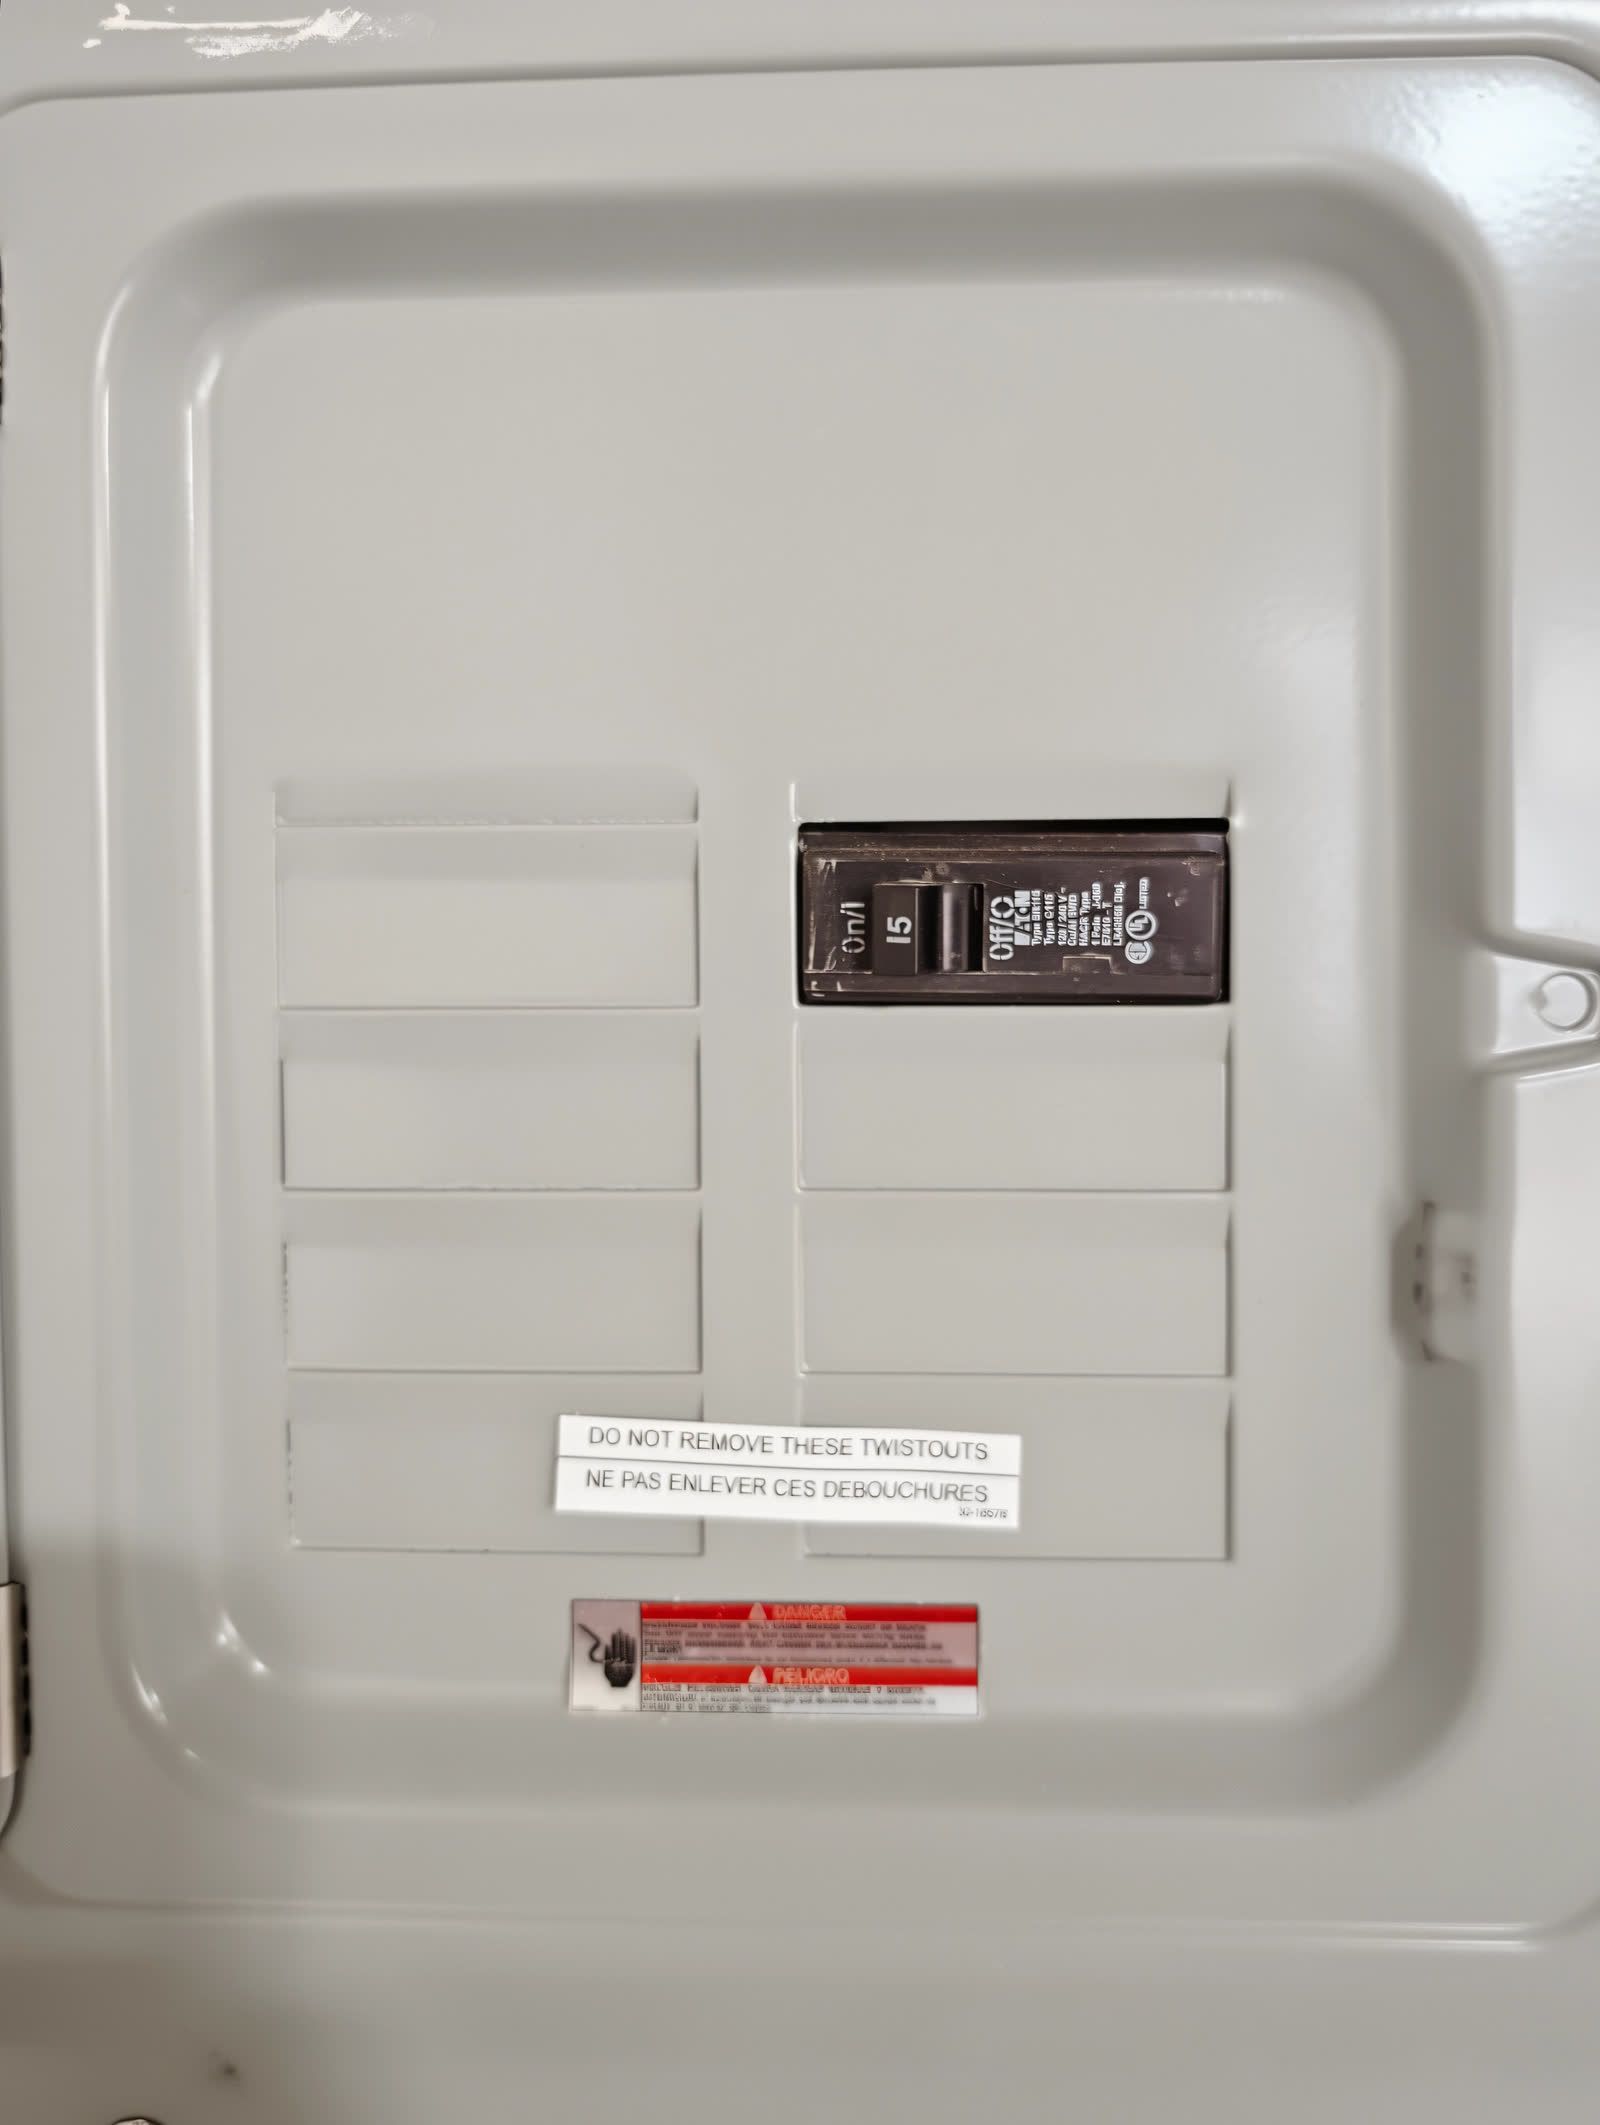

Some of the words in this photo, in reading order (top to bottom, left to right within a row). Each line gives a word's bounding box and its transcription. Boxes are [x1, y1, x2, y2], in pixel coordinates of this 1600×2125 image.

[1080, 892, 1091, 915] Type
[886, 916, 912, 944] 15
[1032, 923, 1042, 946] Type
[1044, 921, 1055, 946] Type
[1079, 917, 1089, 946] HACR
[1092, 917, 1100, 938] Pole
[589, 1427, 621, 1444] DO
[628, 1429, 675, 1448] NOT
[681, 1431, 774, 1453] REMOVE
[781, 1437, 853, 1455] THESE
[861, 1438, 988, 1460] TWISTOUTS
[586, 1469, 614, 1487] NE
[622, 1471, 661, 1489] PAS
[669, 1473, 766, 1495] ENLEVER
[774, 1479, 816, 1497] CES
[824, 1480, 988, 1502] DEBOUCHURES
[772, 1605, 847, 1620] DANGER
[772, 1667, 850, 1684] PELIGRO
